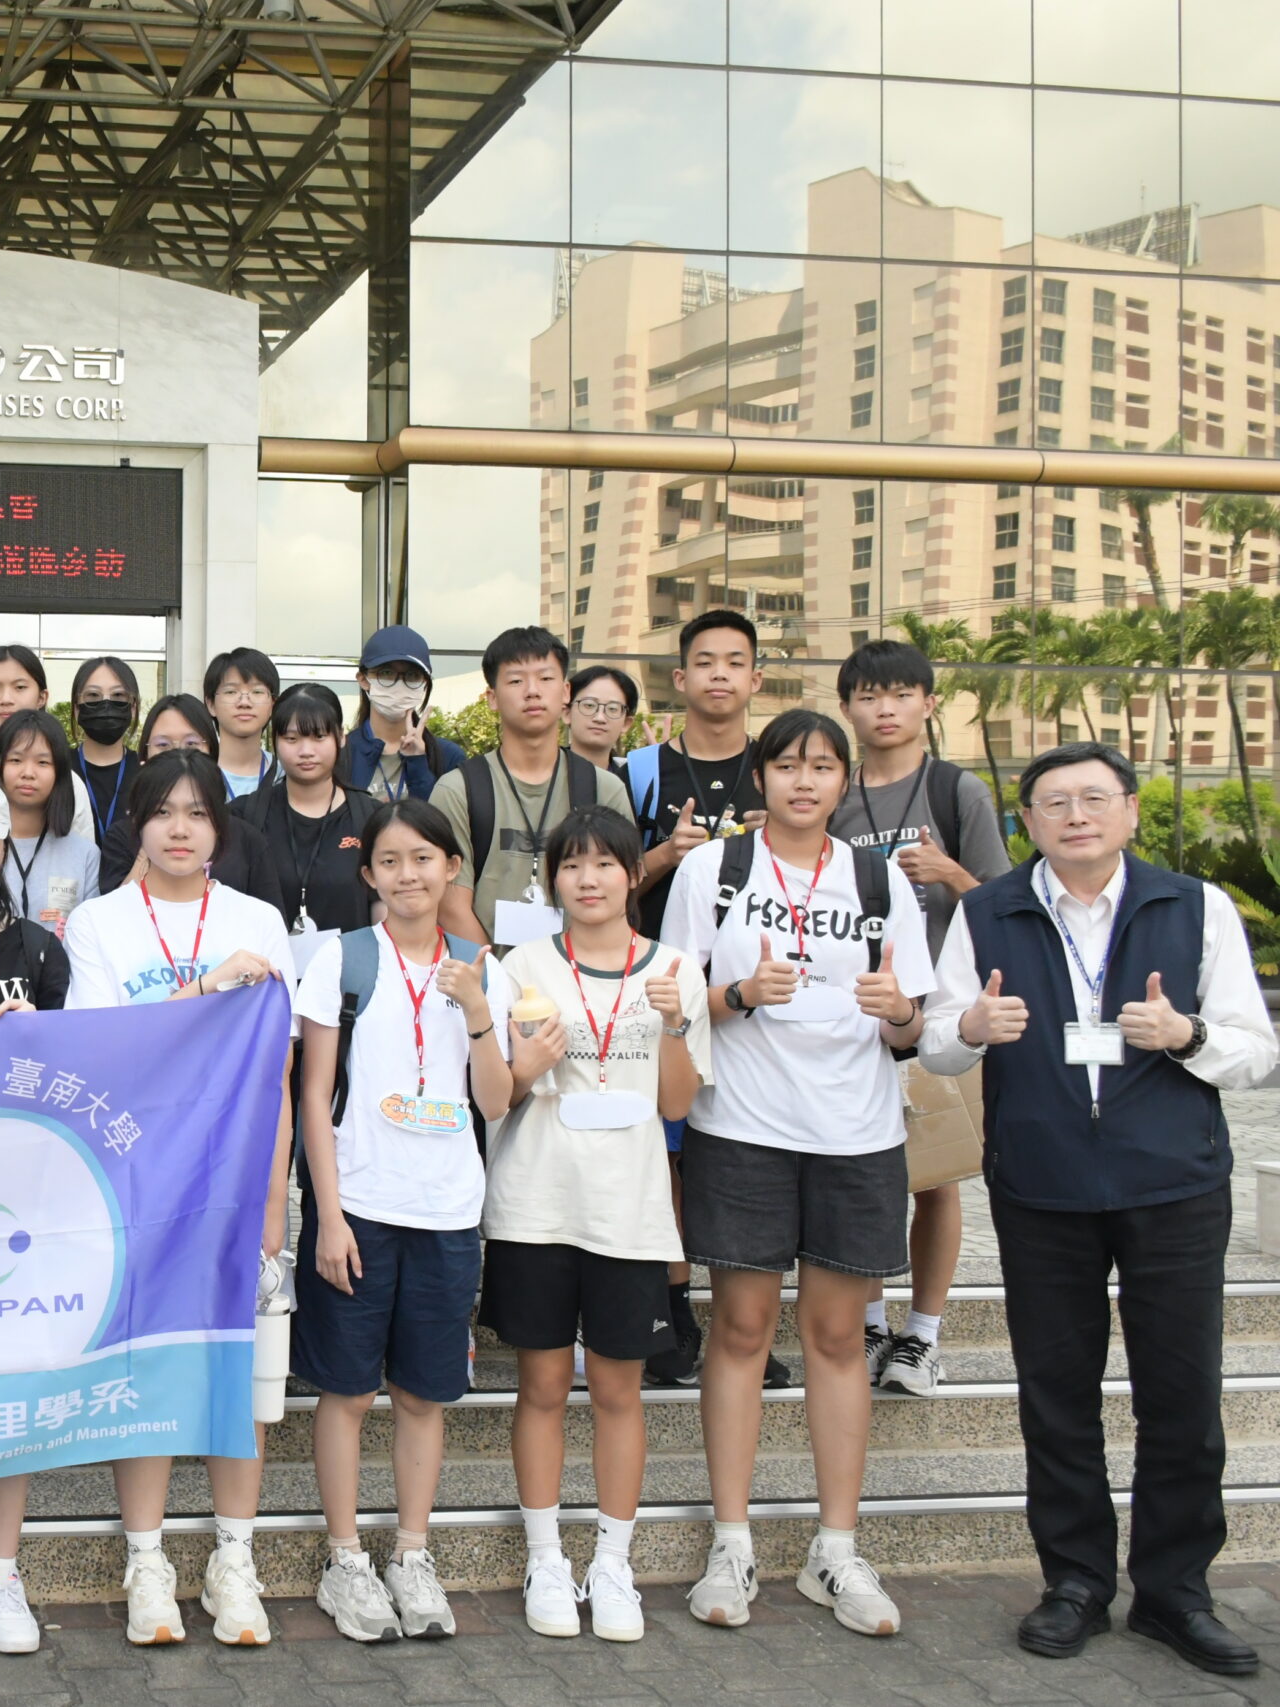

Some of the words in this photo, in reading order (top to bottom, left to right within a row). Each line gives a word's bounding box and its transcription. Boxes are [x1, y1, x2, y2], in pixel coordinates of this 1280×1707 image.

[56, 395, 127, 421] CORP.
[850, 827, 930, 847] SOLITD
[617, 1051, 649, 1060] ALIEN
[46, 1432, 73, 1450] and
[76, 1419, 178, 1441] Management
